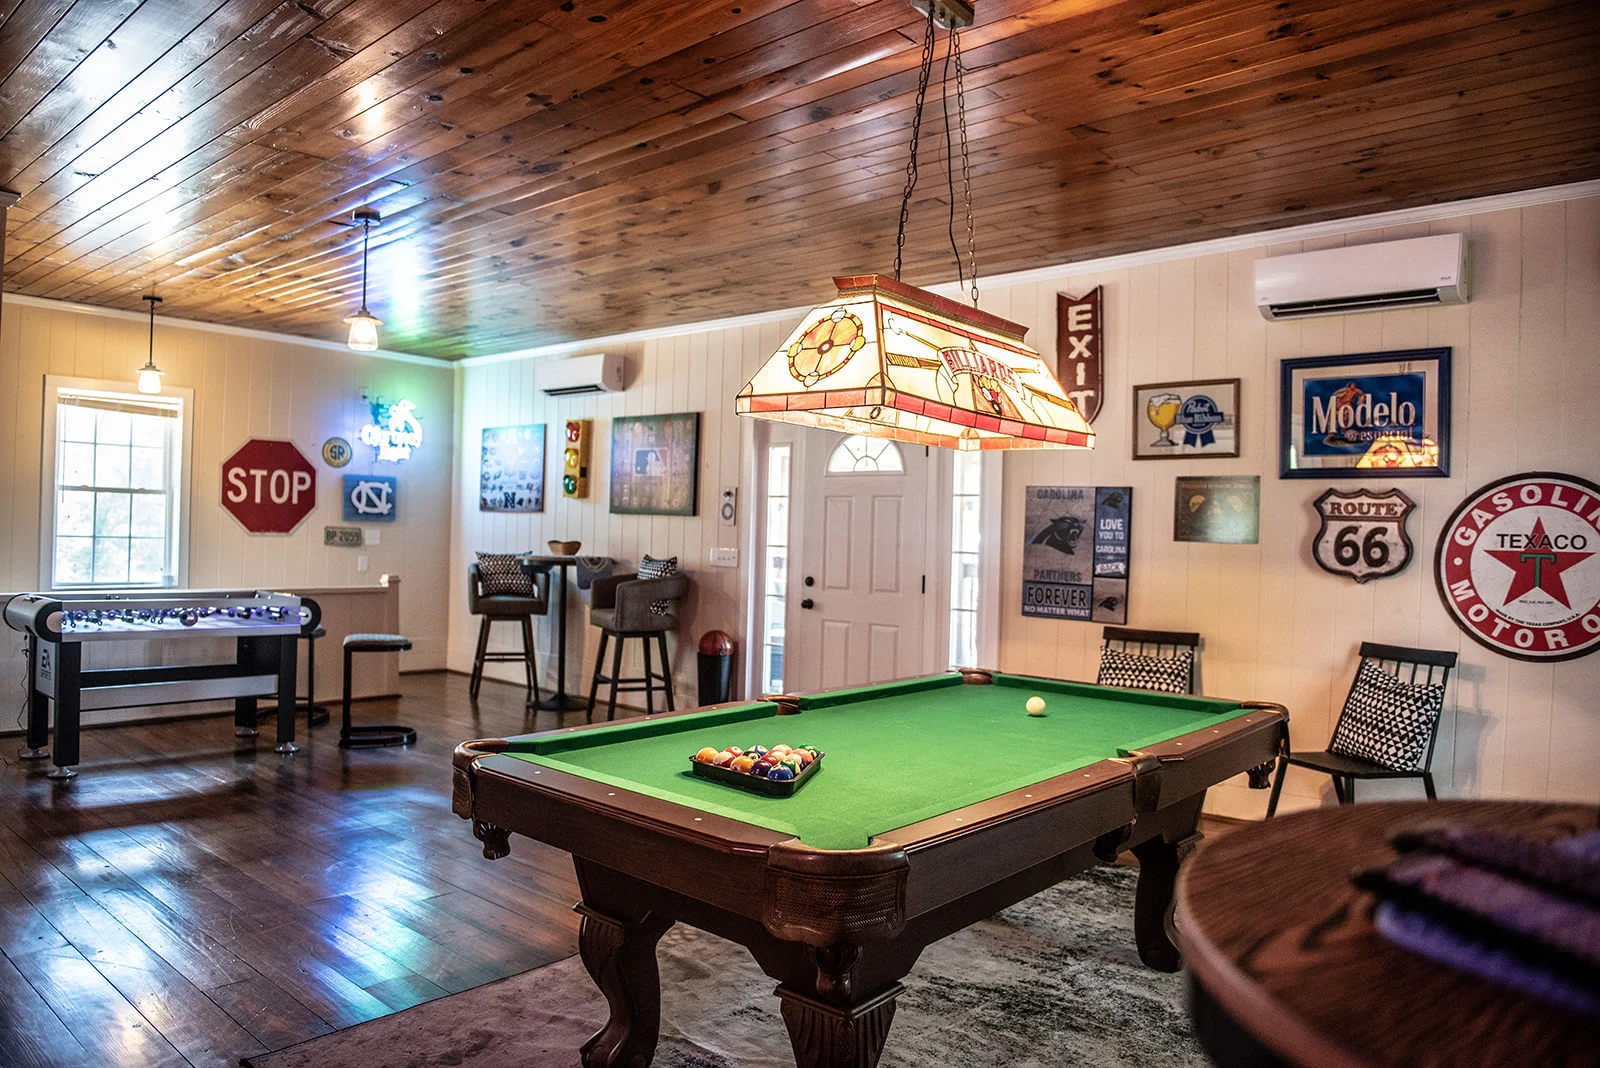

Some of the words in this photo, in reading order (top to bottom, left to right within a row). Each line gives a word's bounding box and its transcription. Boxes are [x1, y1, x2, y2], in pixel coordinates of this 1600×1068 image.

[942, 349, 1018, 388] BILLIARDS
[1067, 303, 1095, 418] EXIT
[1311, 391, 1416, 434] Modelo
[329, 445, 346, 460] SR
[227, 466, 312, 505] STOP
[1037, 488, 1084, 500] CAROLINA
[1329, 501, 1398, 517] ROUTE
[1100, 518, 1123, 530] LOVE
[1099, 531, 1114, 540] YOU
[1115, 531, 1124, 540] TO
[1496, 533, 1587, 550] TEXACO
[1095, 545, 1126, 554] CAROLINA
[1334, 527, 1390, 567] 66
[1033, 568, 1083, 583] PANTHERS
[1520, 553, 1556, 588] T
[1027, 586, 1087, 607] FOREVER
[1024, 605, 1036, 613] NO
[1037, 606, 1066, 616] MATTER
[1067, 609, 1090, 617] WHAT
[1450, 579, 1570, 650] MOTOR
